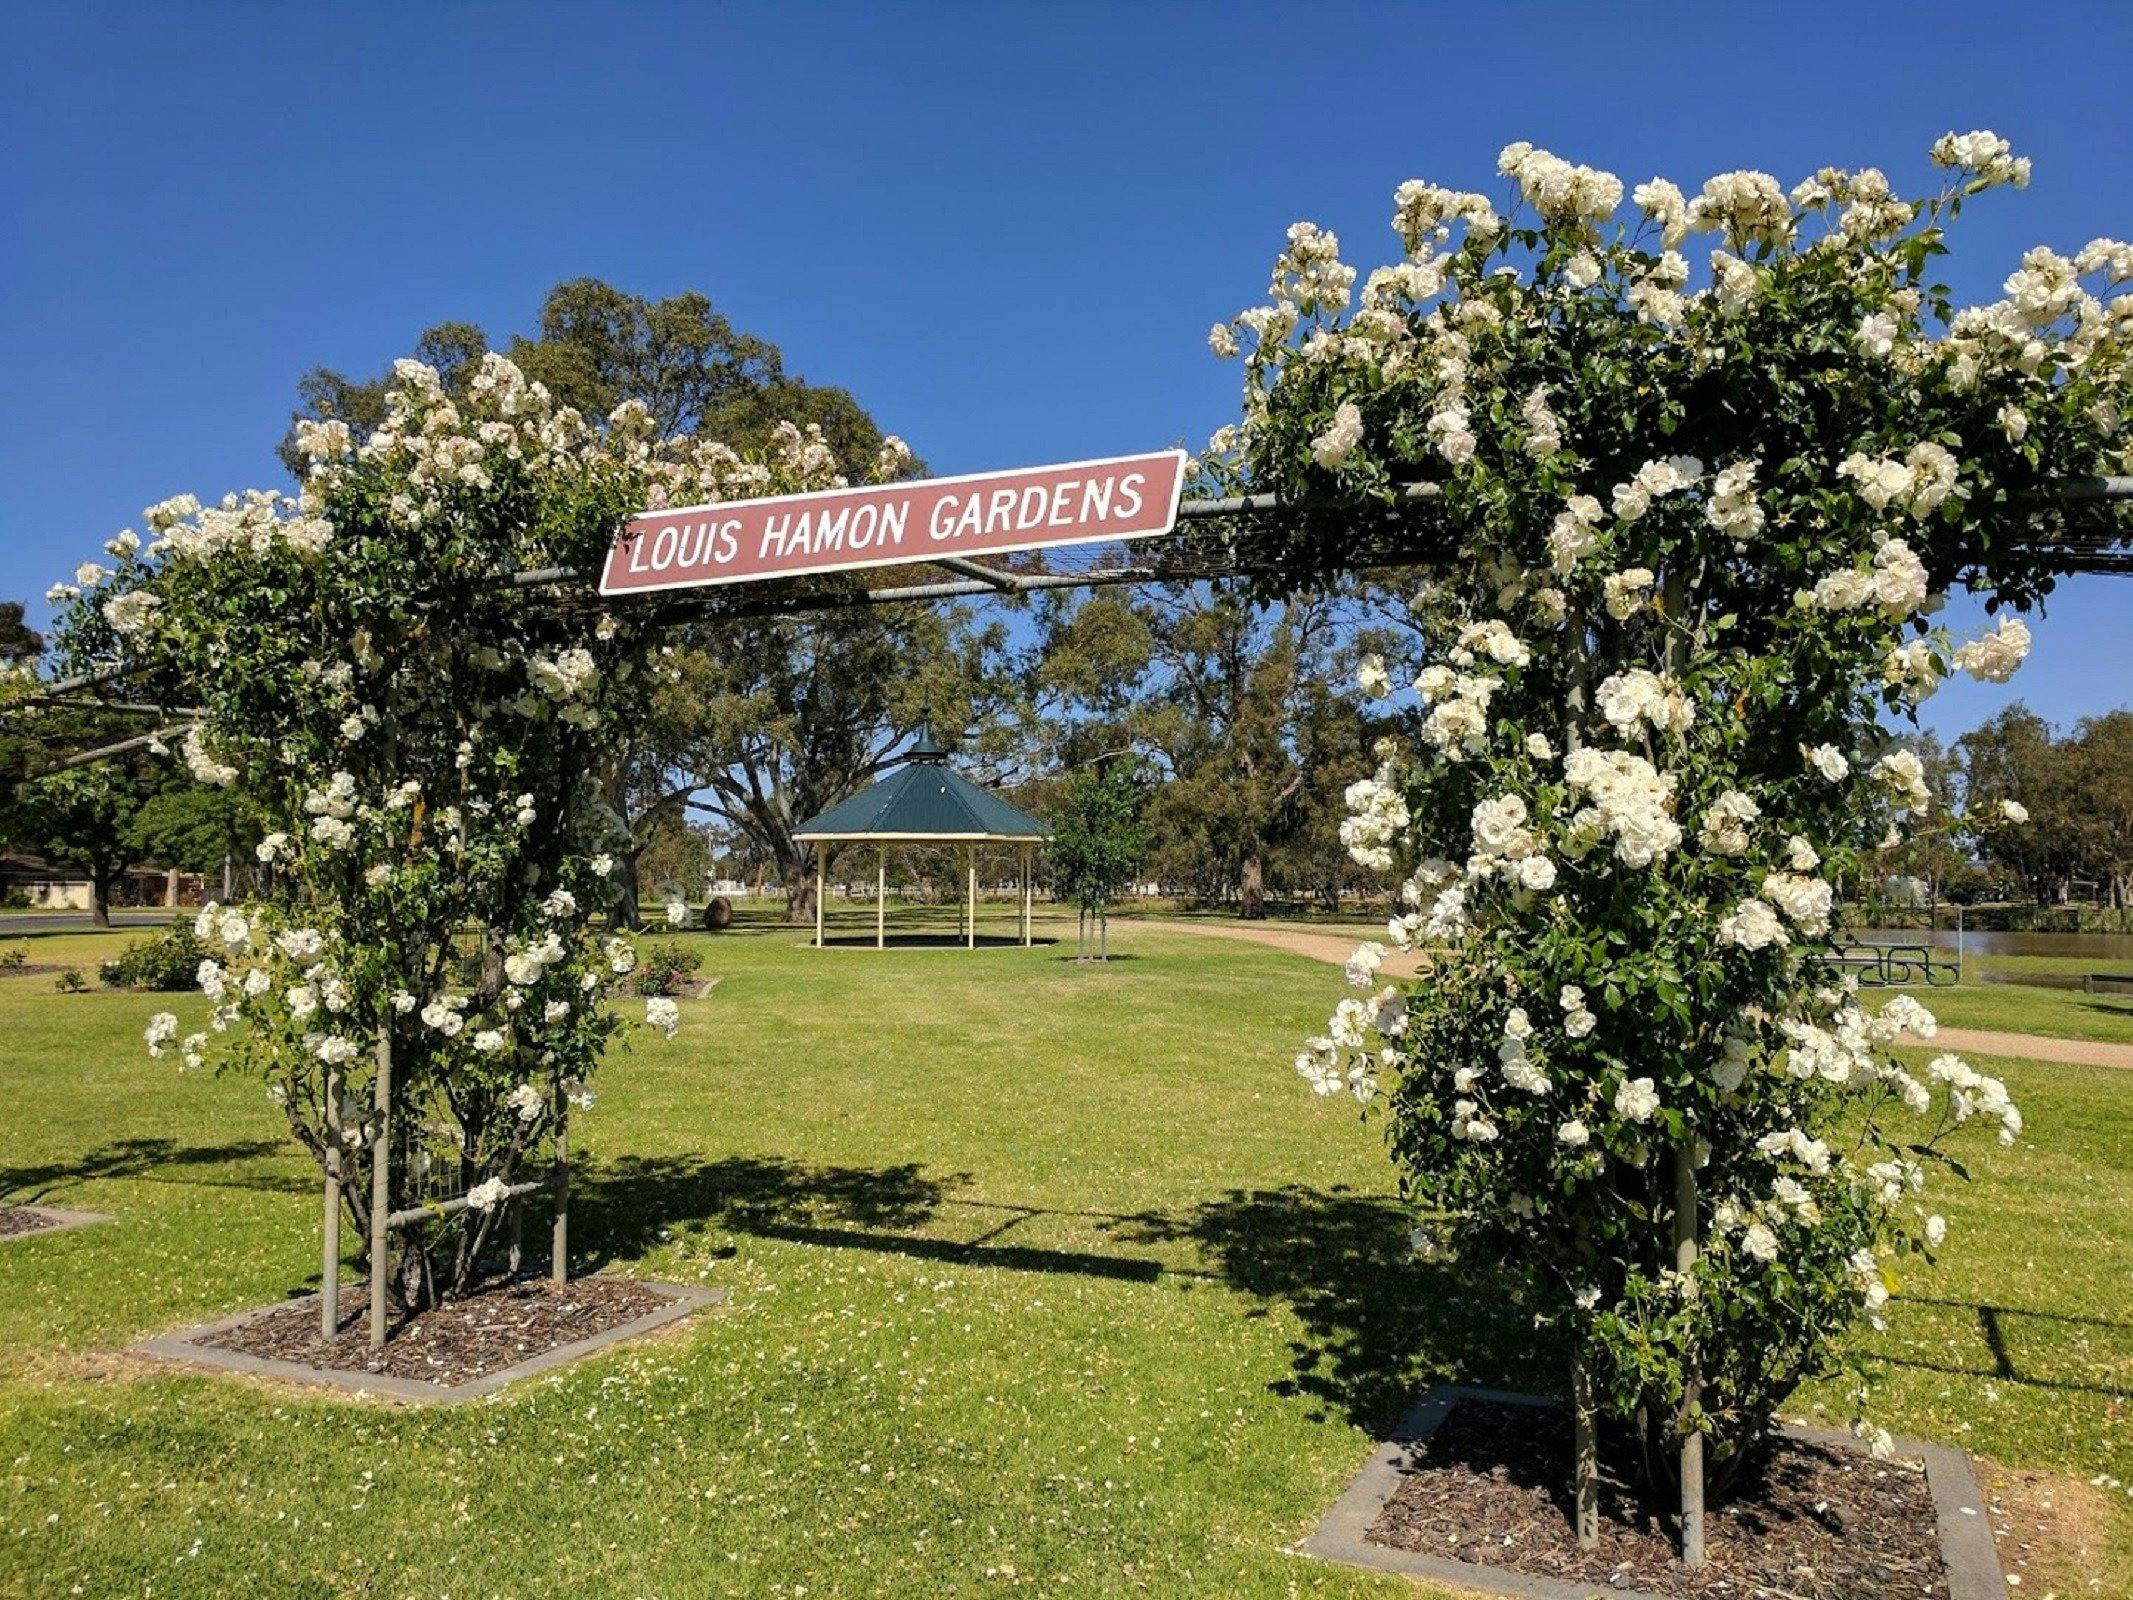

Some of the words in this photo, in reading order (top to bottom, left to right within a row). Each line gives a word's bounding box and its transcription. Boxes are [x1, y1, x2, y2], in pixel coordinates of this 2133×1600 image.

[629, 519, 742, 573] LOUIS
[759, 502, 909, 558] HAMON
[930, 474, 1145, 540] GARDENS
